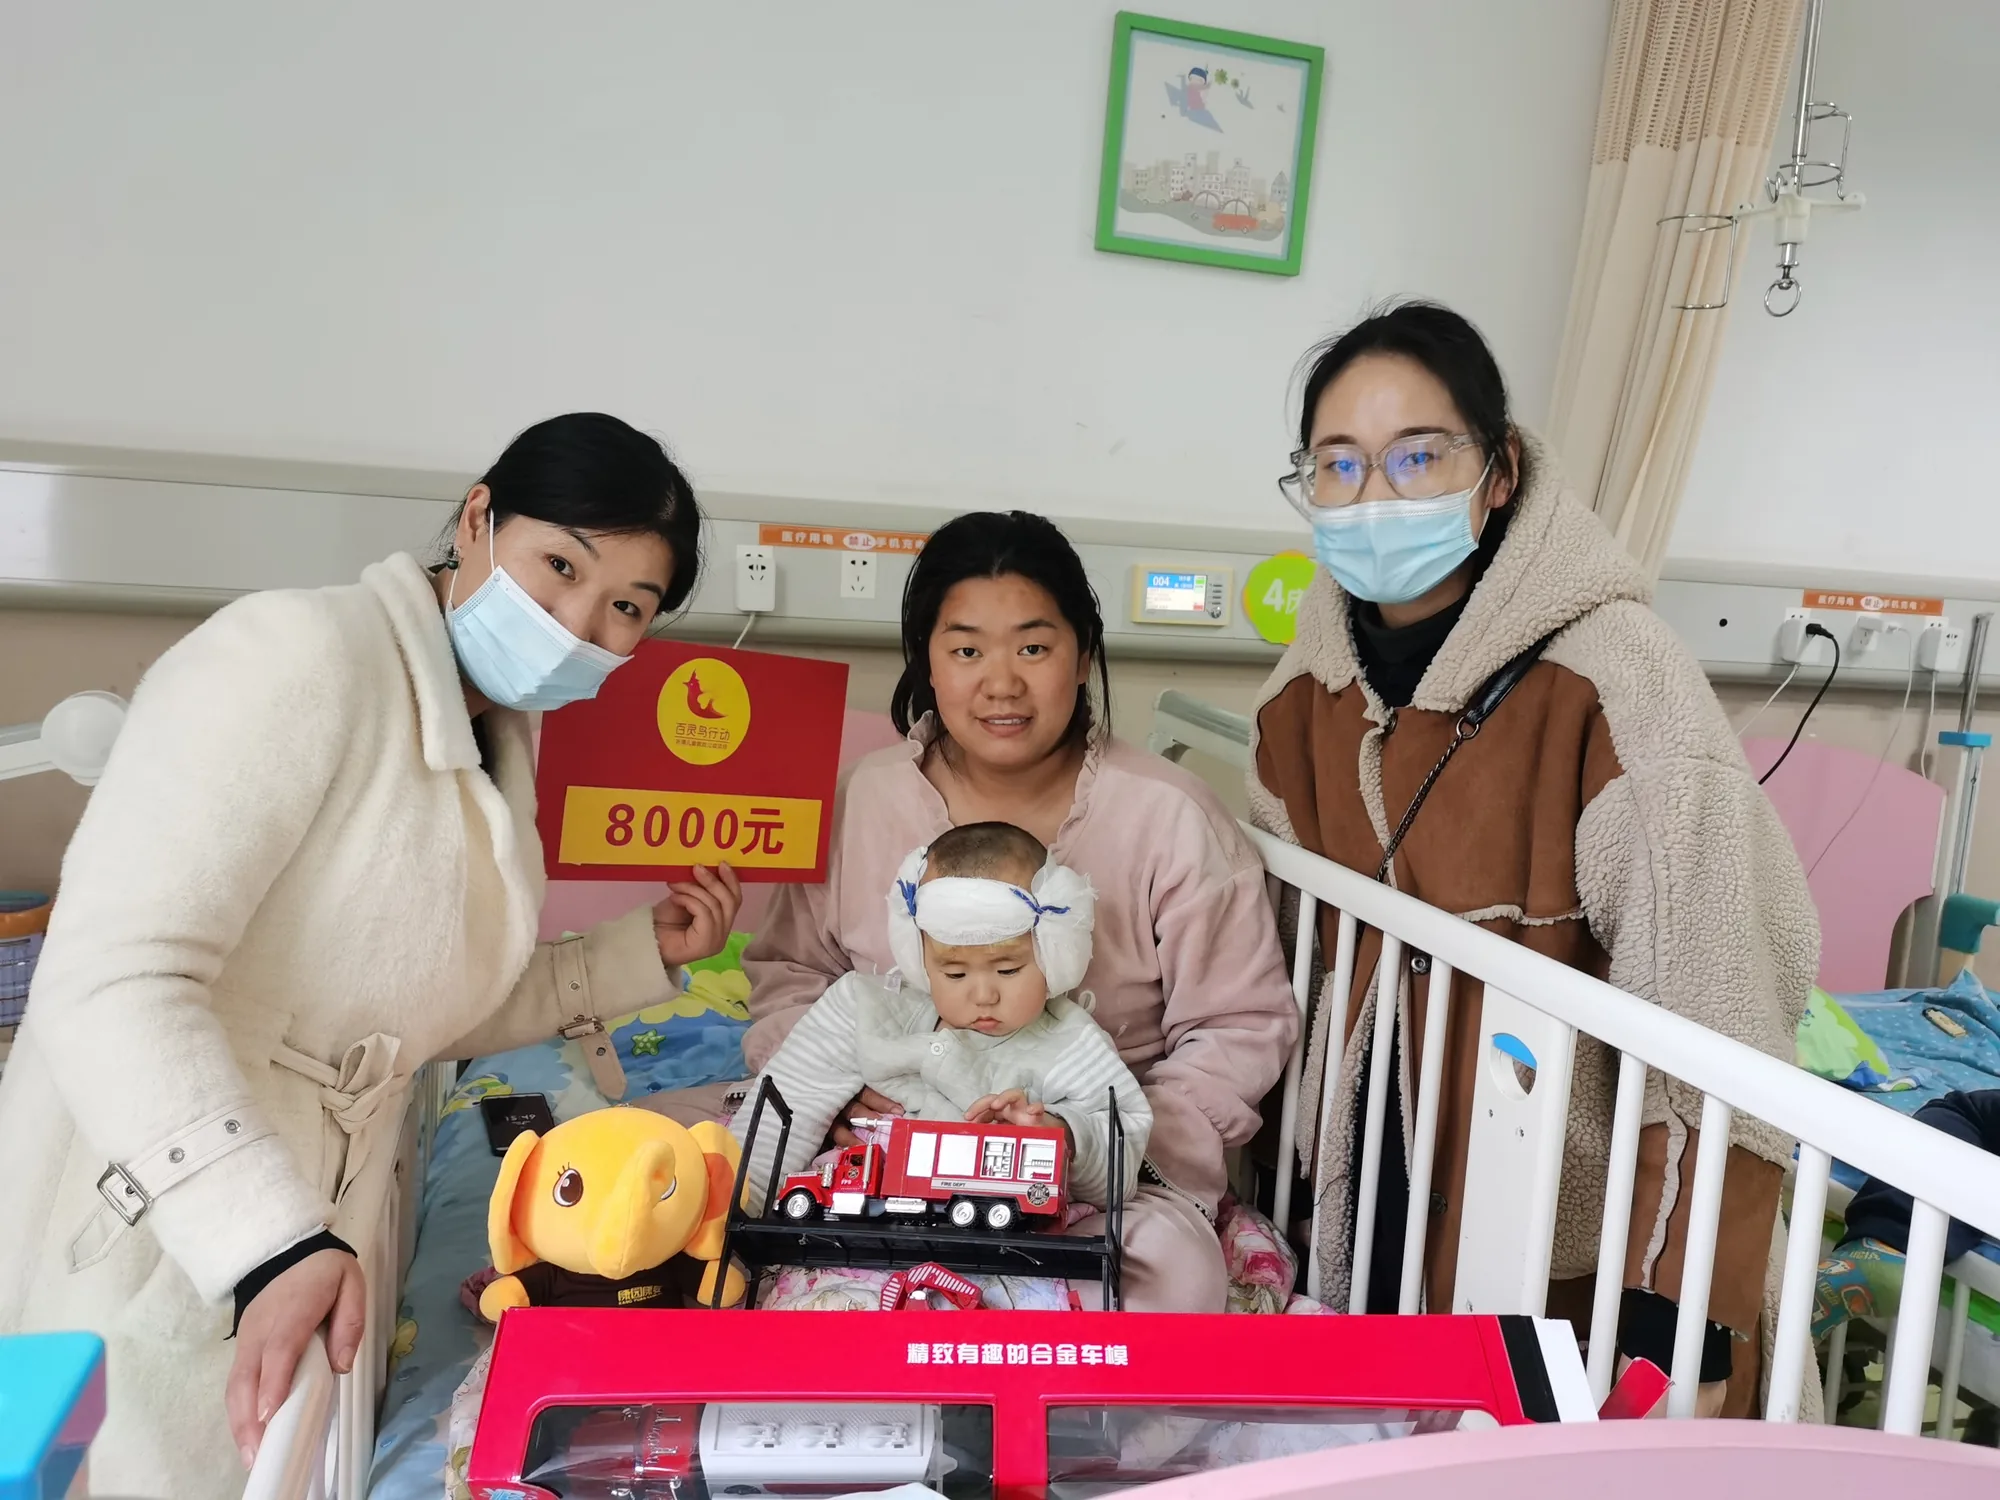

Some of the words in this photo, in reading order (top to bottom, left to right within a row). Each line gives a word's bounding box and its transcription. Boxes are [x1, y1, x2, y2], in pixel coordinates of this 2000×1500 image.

[781, 531, 834, 545] 医疗用电
[1152, 576, 1170, 586] 004
[675, 722, 731, 741] 百灵鸟行动
[605, 803, 785, 856] 8000元
[907, 1342, 1129, 1366] 精致有趣的合金车模
